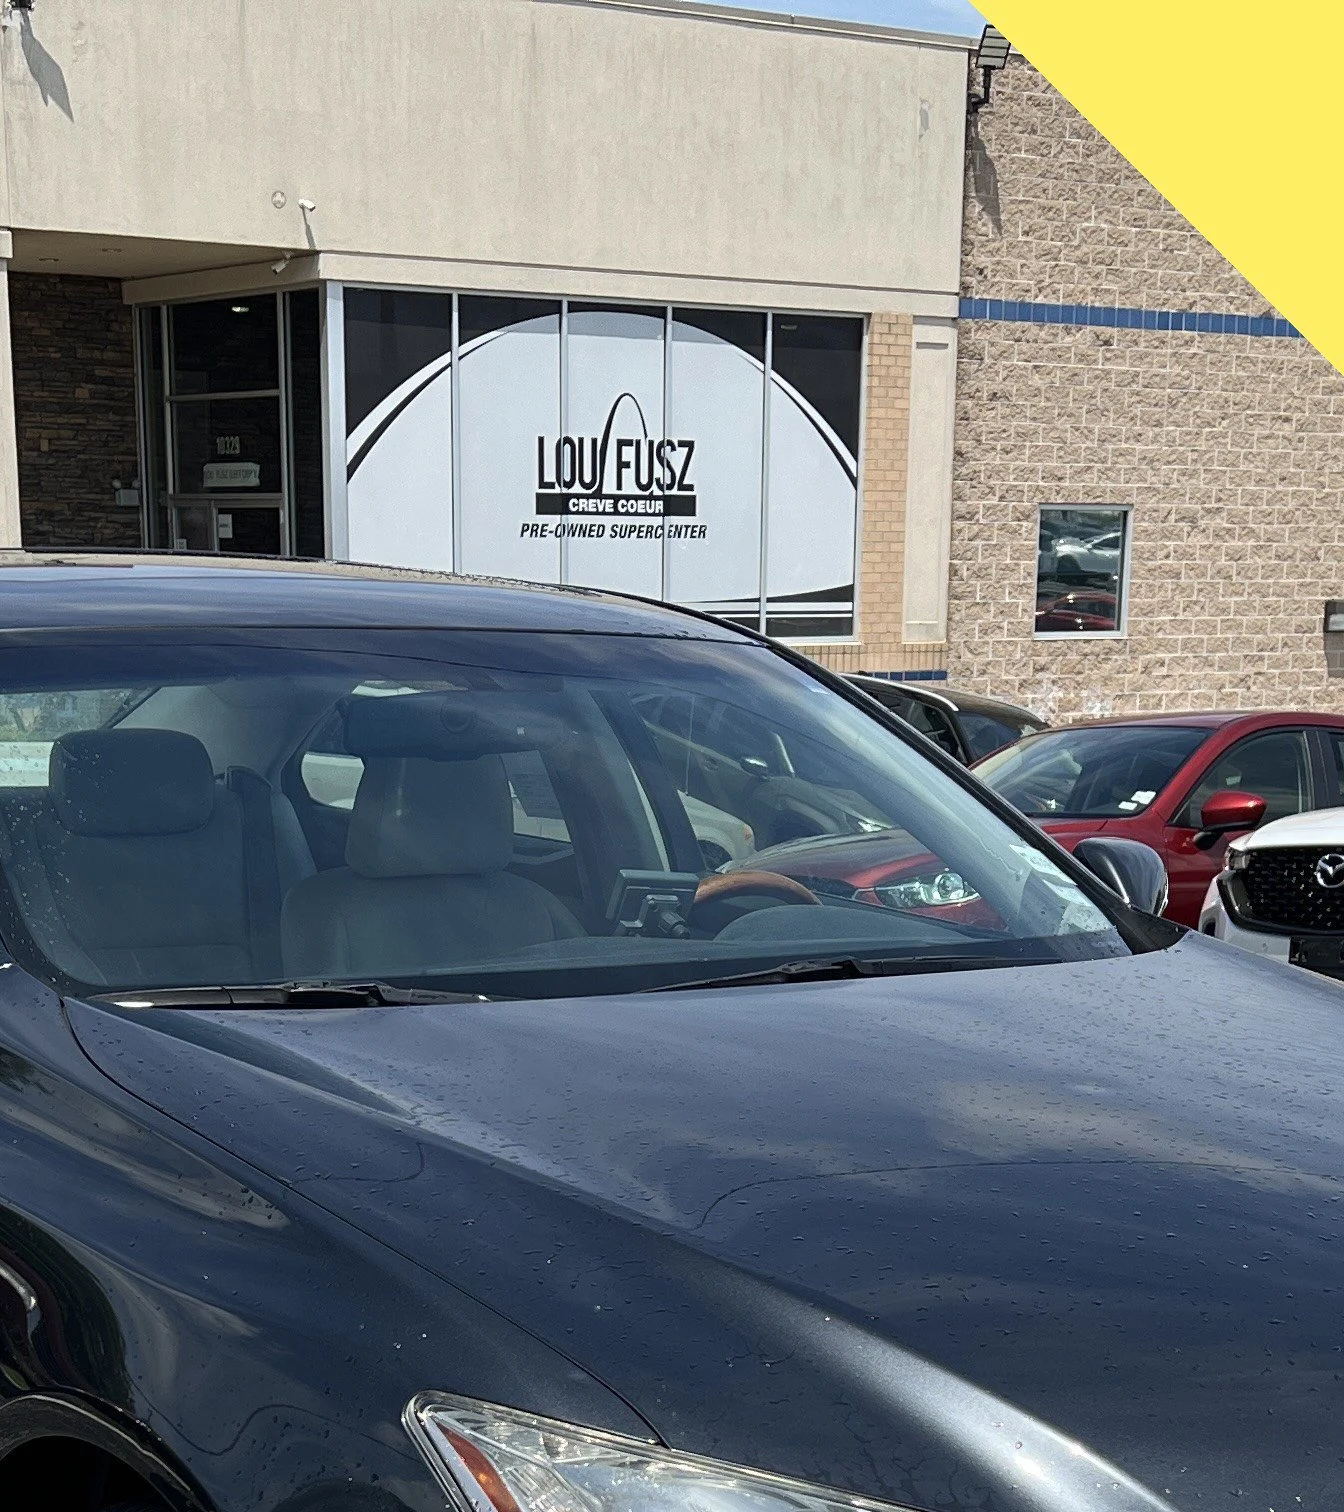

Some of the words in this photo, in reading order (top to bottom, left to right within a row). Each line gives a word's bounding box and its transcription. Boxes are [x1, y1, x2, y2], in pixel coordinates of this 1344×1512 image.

[537, 435, 598, 491] LOU
[615, 438, 696, 492] FUSZ
[568, 498, 615, 513] CREVE
[617, 500, 664, 514] COEUR
[519, 523, 606, 539] PRE-OWNED
[609, 524, 708, 539] SUPERCENTER
